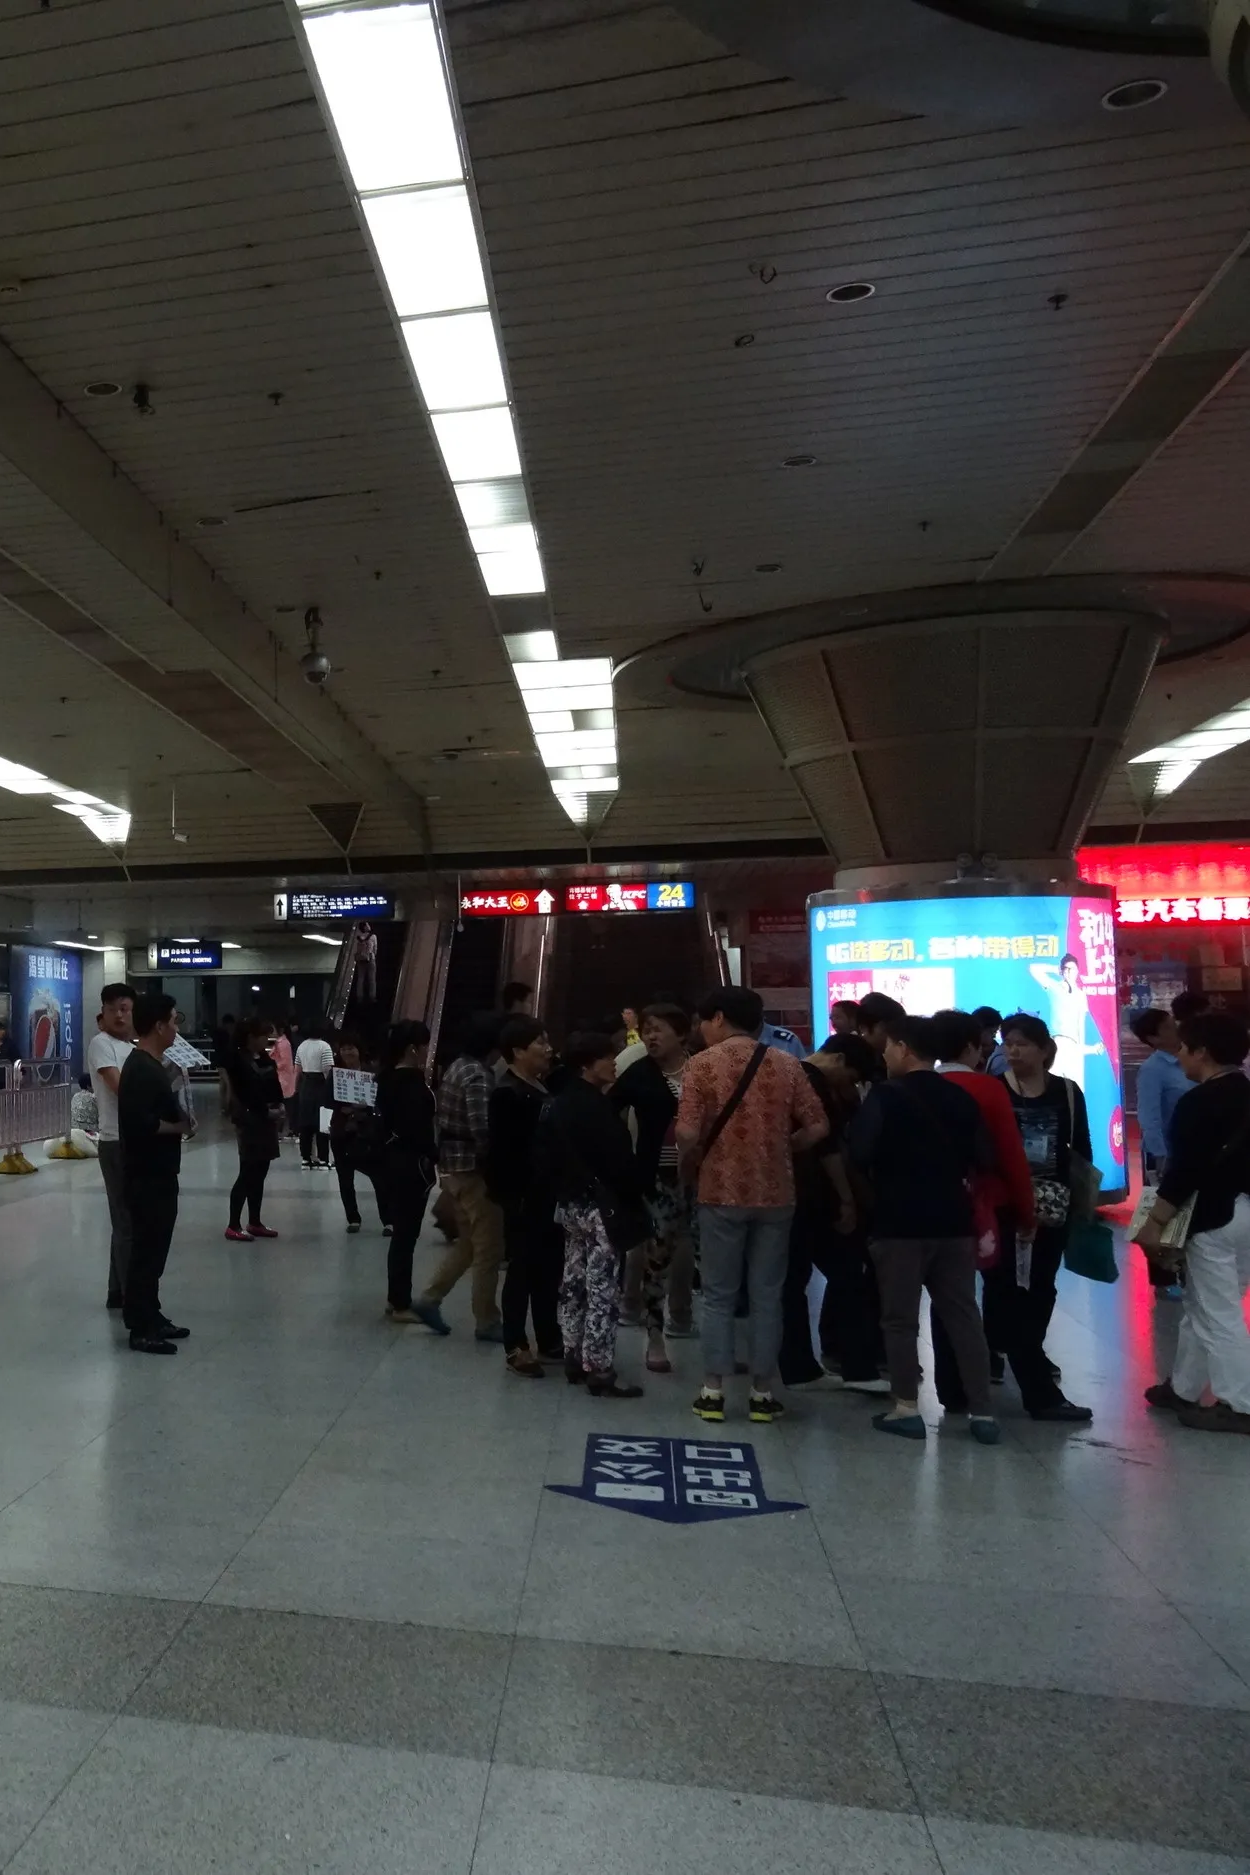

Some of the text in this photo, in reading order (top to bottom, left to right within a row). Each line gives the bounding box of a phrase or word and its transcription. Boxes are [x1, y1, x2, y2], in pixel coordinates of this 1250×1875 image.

[622, 890, 646, 899] KFC
[658, 884, 684, 900] 24
[461, 896, 509, 909] 永和大王
[827, 907, 857, 920] 中国移动
[28, 955, 68, 981] 渴望就现在
[336, 1069, 357, 1081] 台州
[592, 1438, 666, 1480] 公交
[682, 1444, 752, 1488] 出口
